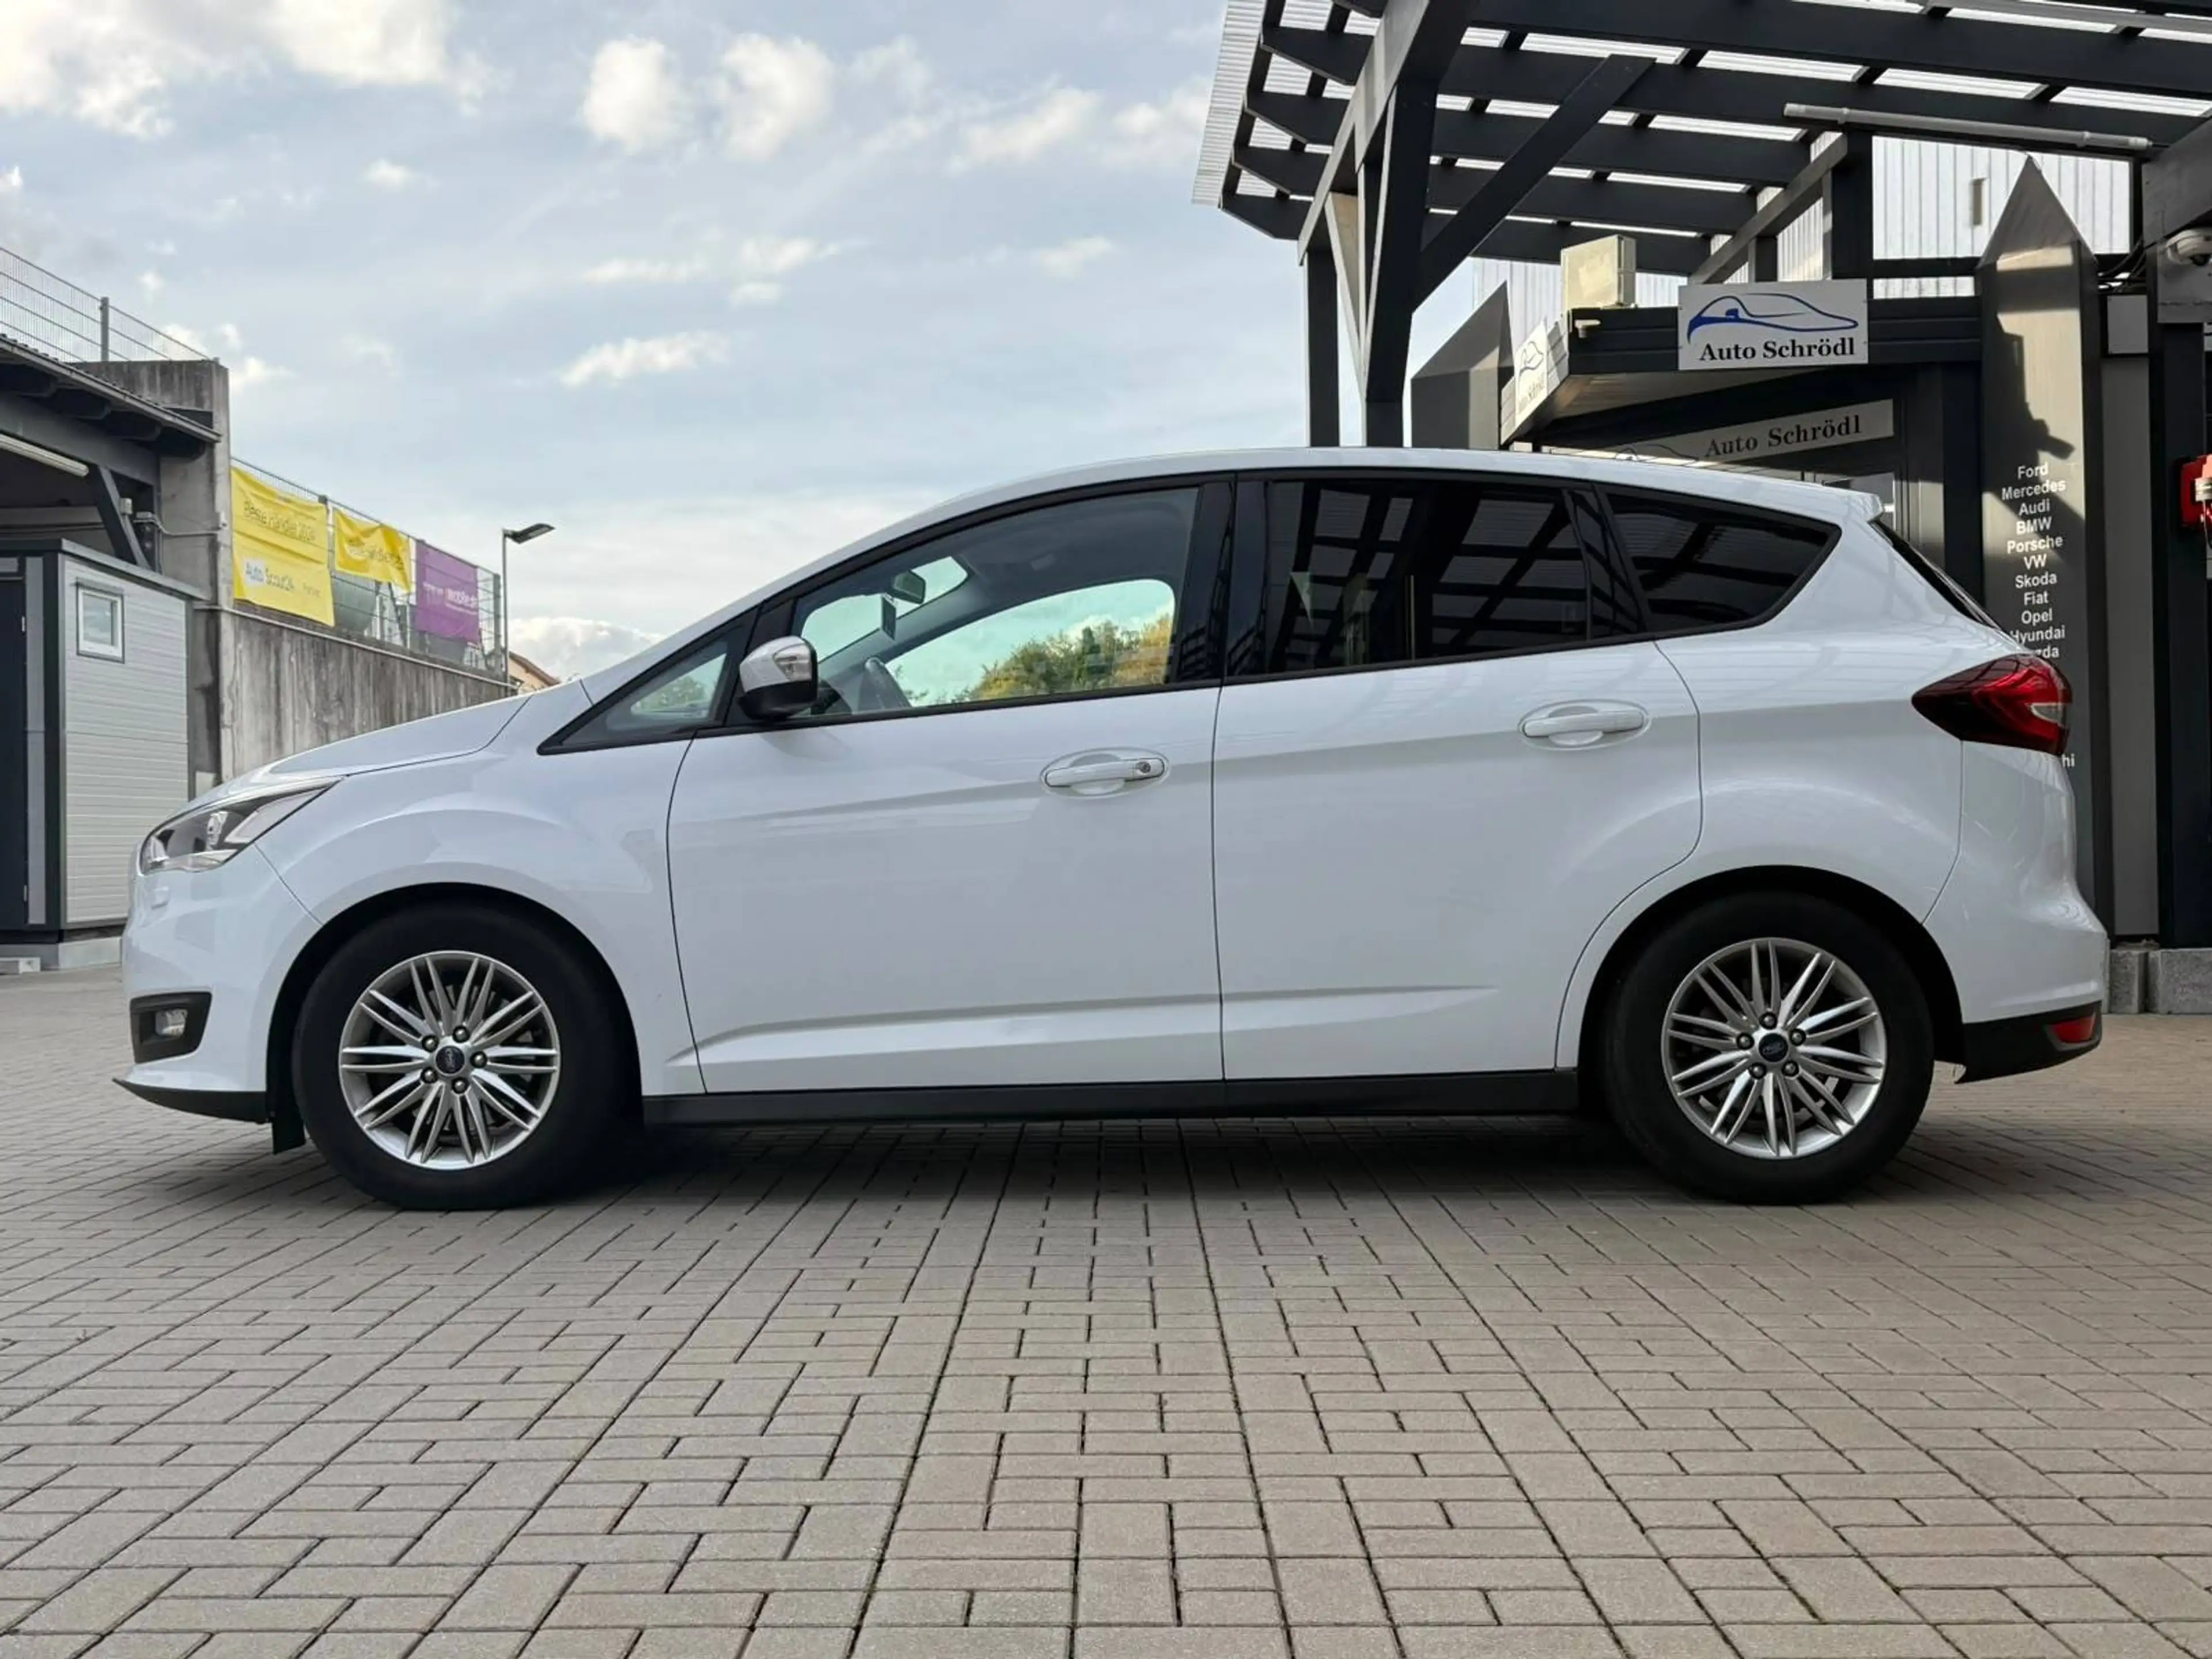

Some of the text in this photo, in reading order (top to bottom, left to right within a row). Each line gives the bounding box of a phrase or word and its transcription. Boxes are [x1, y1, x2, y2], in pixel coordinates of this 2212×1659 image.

[1699, 337, 1855, 361] Auto Schrödl
[1705, 415, 1863, 457] Auto Schrödl
[2017, 461, 2049, 480] Ford
[2001, 479, 2067, 500] Mercedes
[2018, 498, 2051, 516] Audi
[2016, 516, 2052, 535] BMW
[2007, 535, 2064, 555] Porsche
[2024, 554, 2047, 570] VW
[2015, 571, 2058, 589] Skoda
[2024, 590, 2049, 606] Fiat
[2021, 608, 2054, 627] Opel
[2010, 624, 2066, 645] Hyundai
